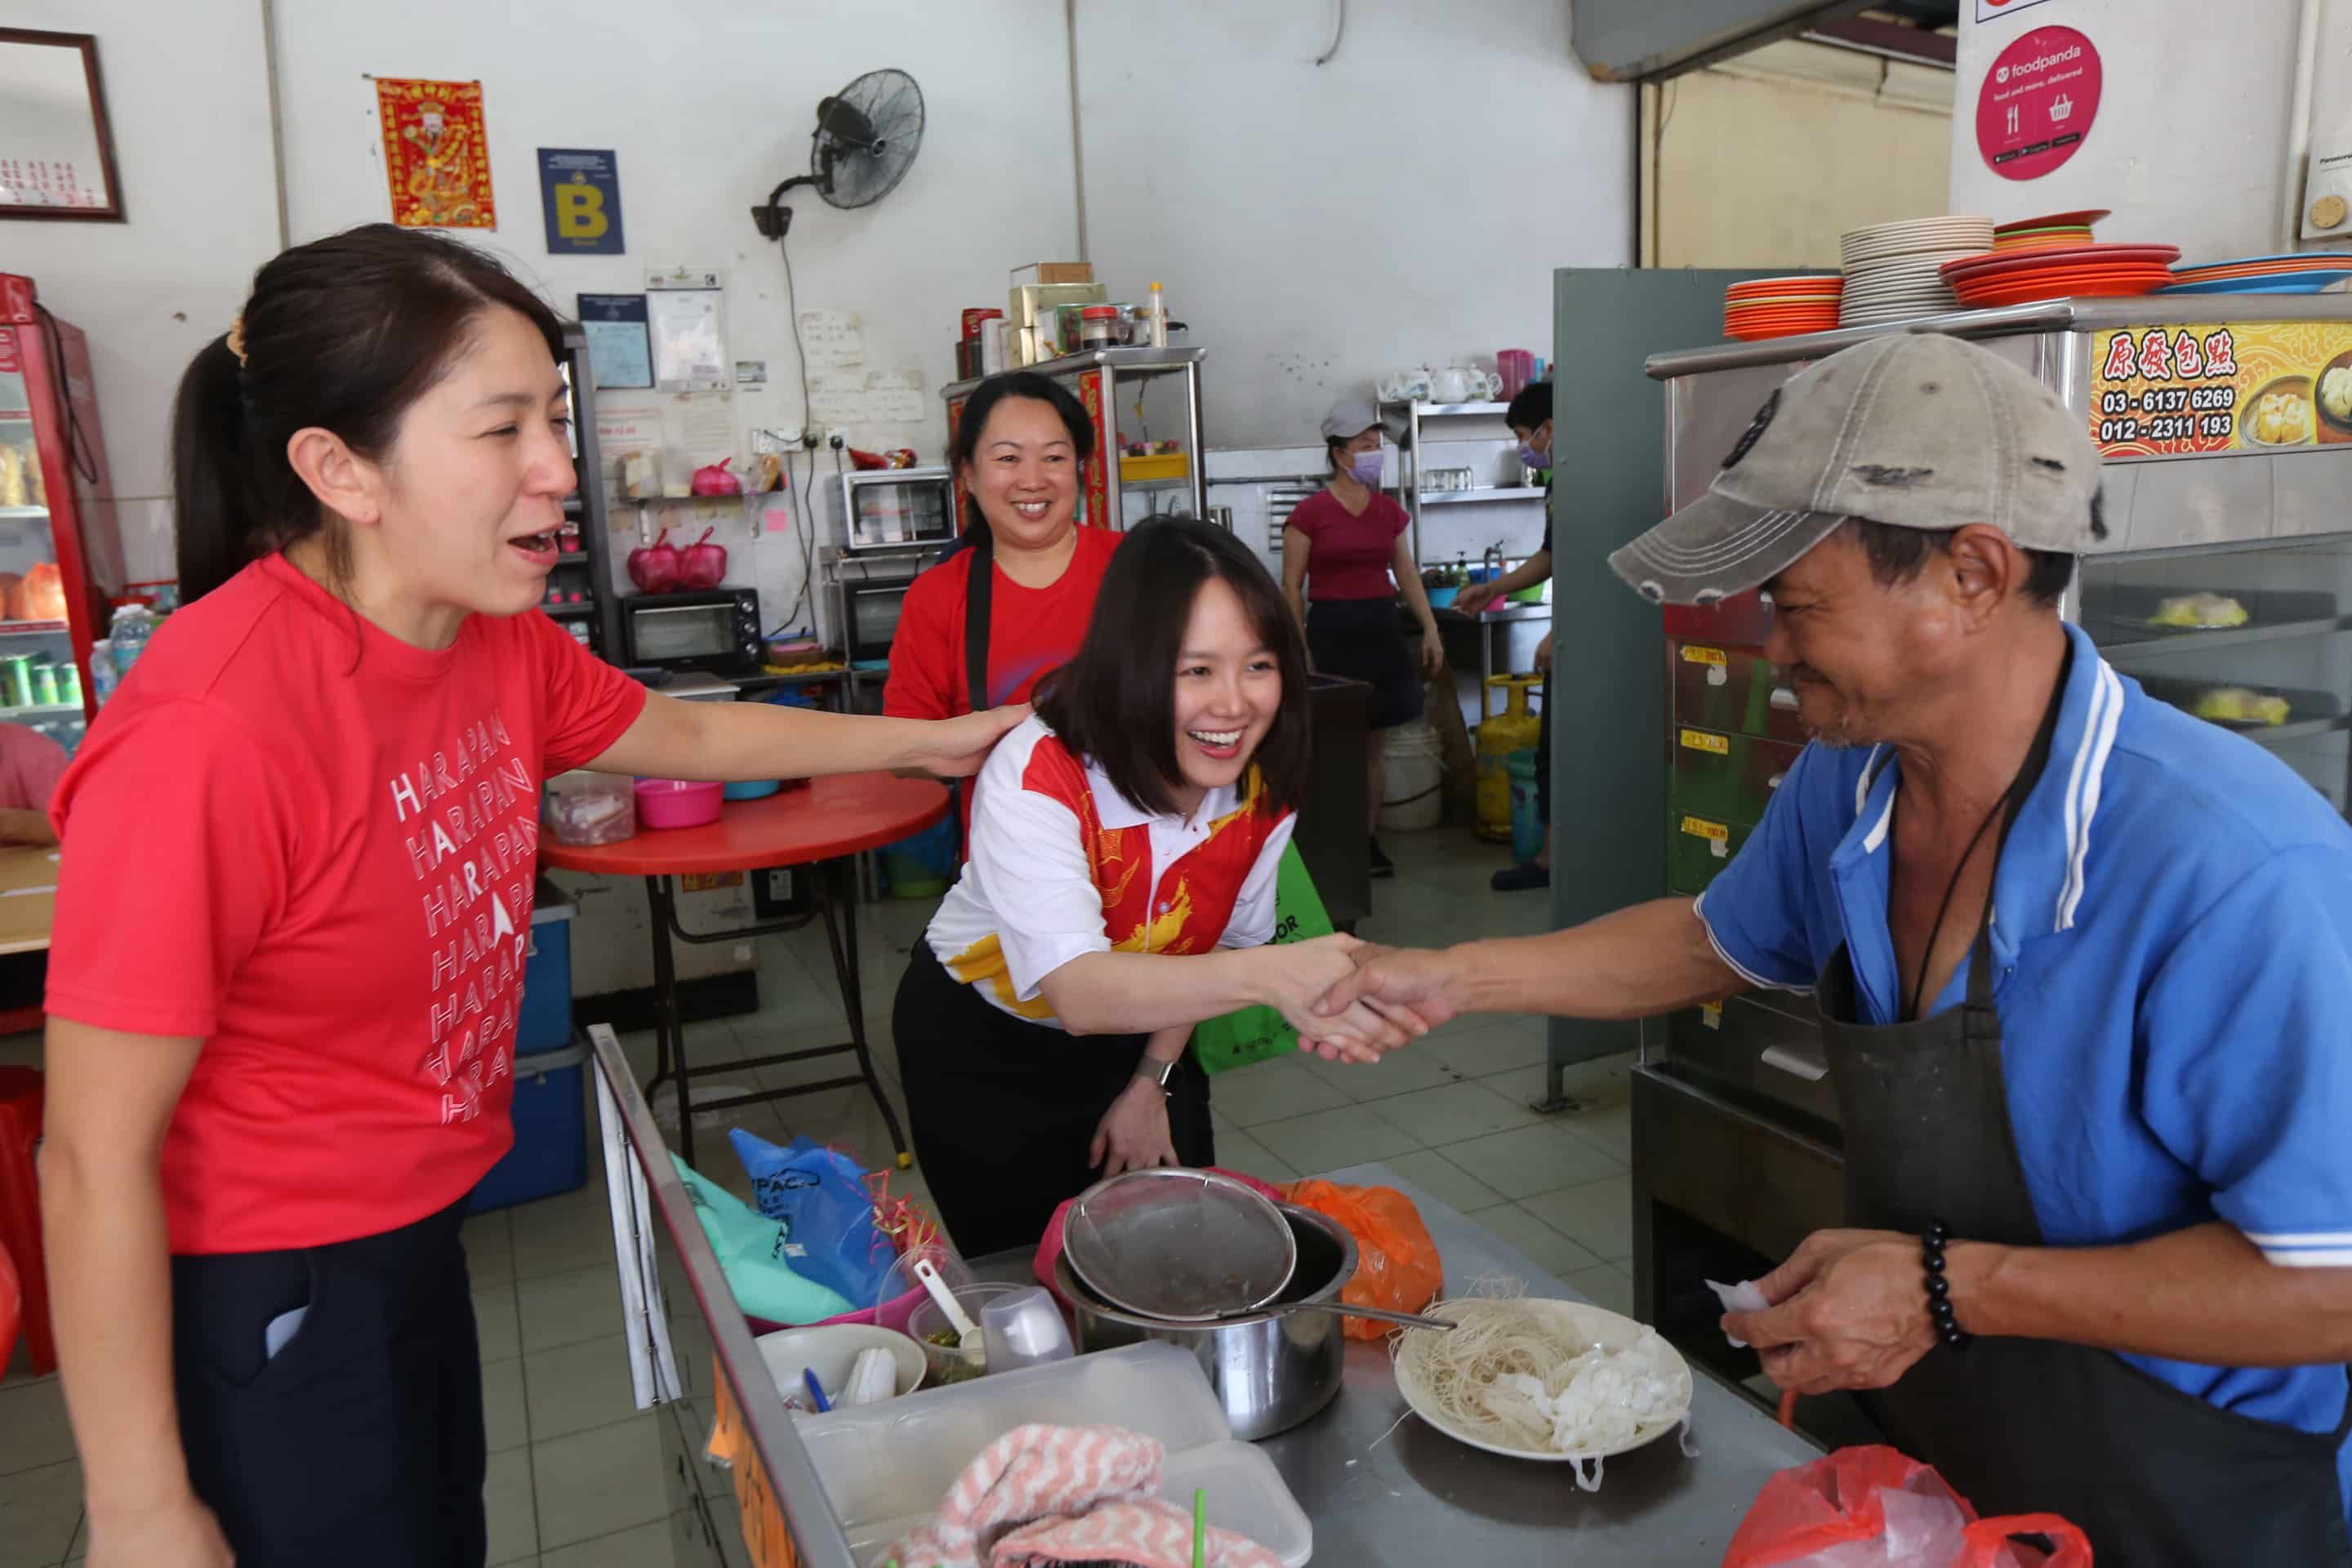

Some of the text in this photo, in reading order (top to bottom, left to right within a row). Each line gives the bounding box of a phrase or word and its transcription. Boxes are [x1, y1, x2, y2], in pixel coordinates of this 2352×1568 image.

[2012, 45, 2082, 78] foodpanda
[555, 183, 609, 238] B
[2105, 329, 2237, 380] 原發包點
[2103, 394, 2127, 412] 03
[2143, 391, 2188, 411] 6137
[2191, 388, 2234, 408] 6269
[2100, 421, 2136, 441] 012
[2151, 418, 2194, 439] 2311
[2200, 415, 2231, 435] 193
[390, 709, 511, 822] HARAPAN
[406, 758, 533, 880] HARAPAN
